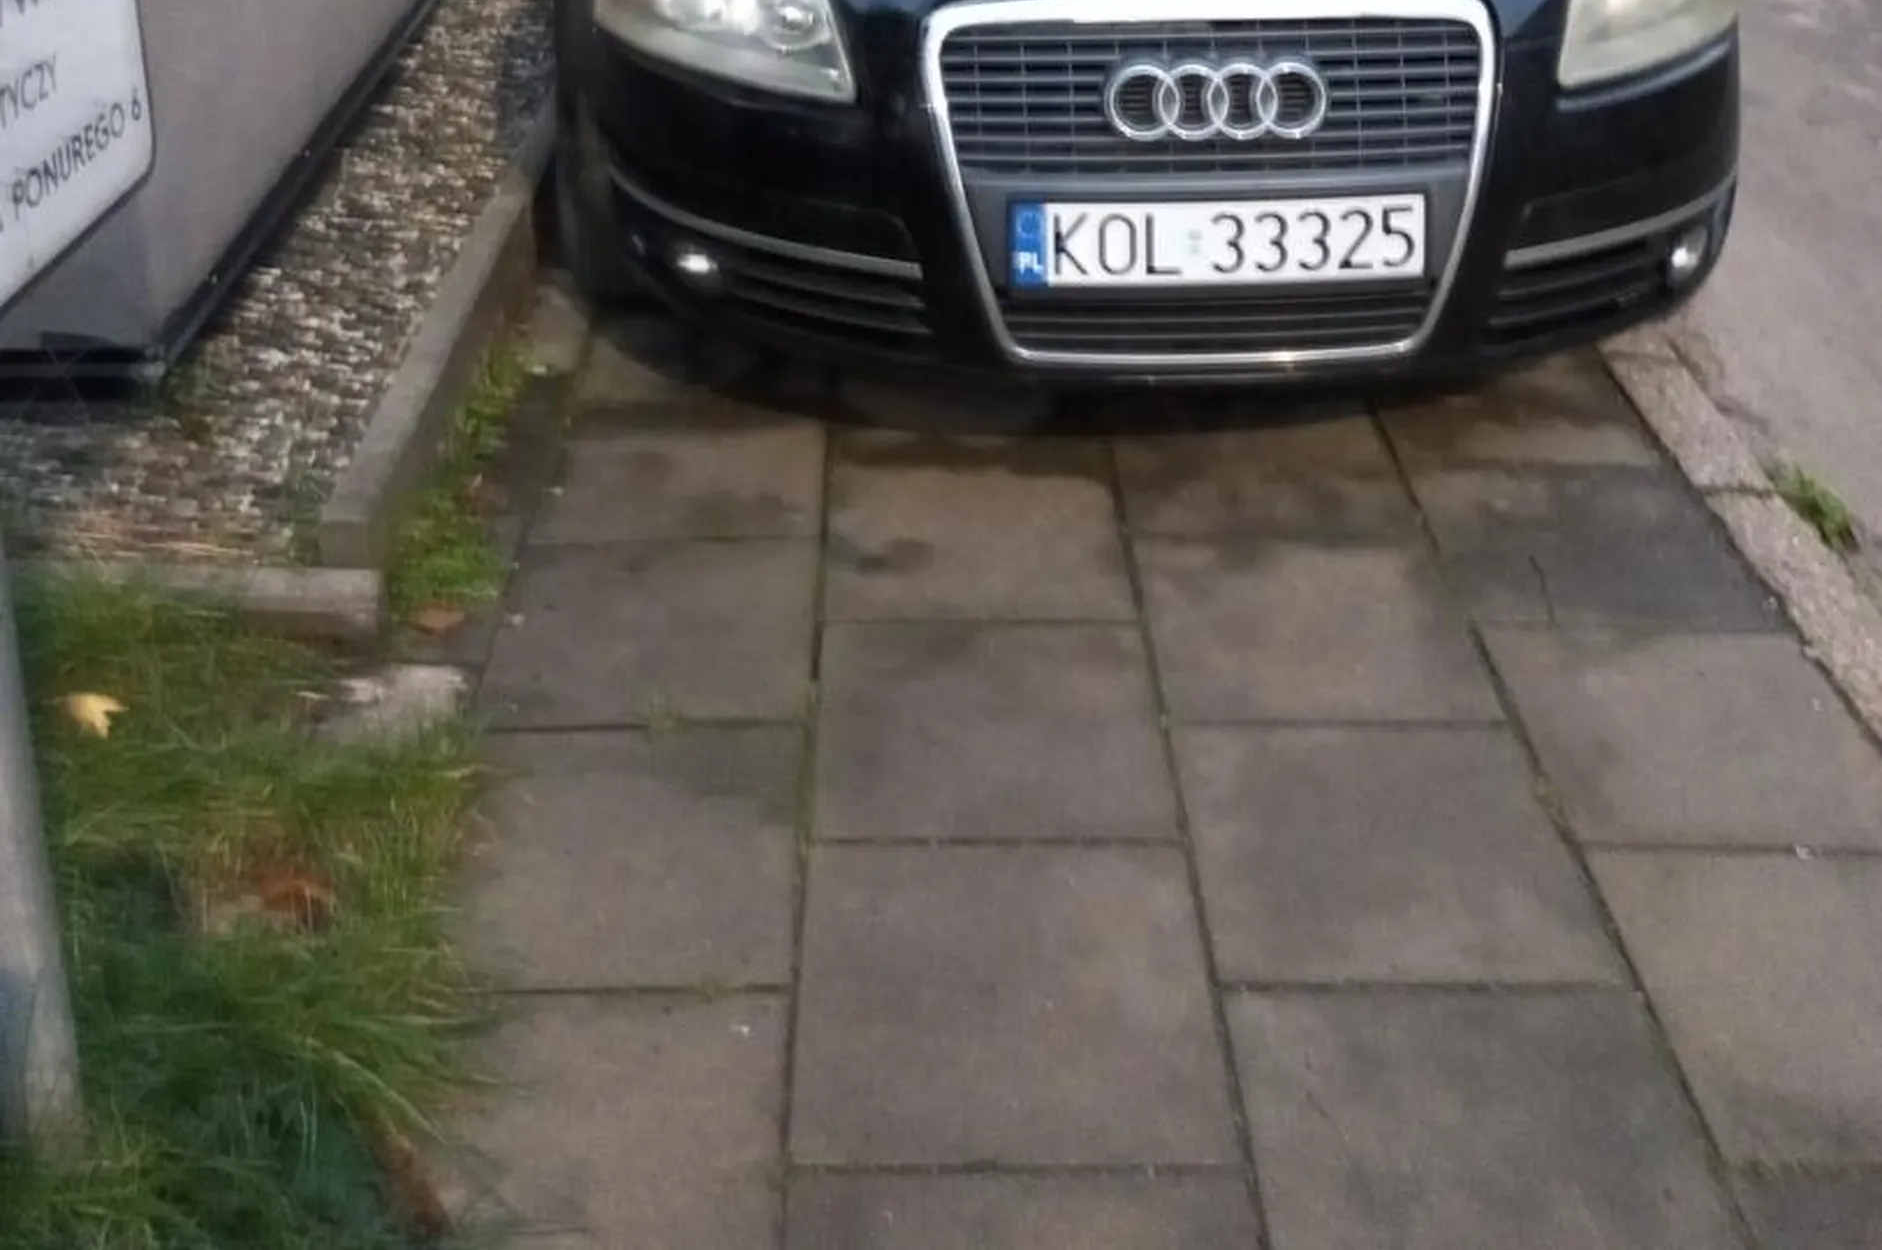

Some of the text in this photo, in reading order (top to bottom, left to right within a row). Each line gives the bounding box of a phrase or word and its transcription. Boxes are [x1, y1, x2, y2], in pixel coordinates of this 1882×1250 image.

[12, 102, 126, 219] PONUREGO
[1017, 253, 1043, 273] PL
[1053, 205, 1416, 277] KOL 33325
